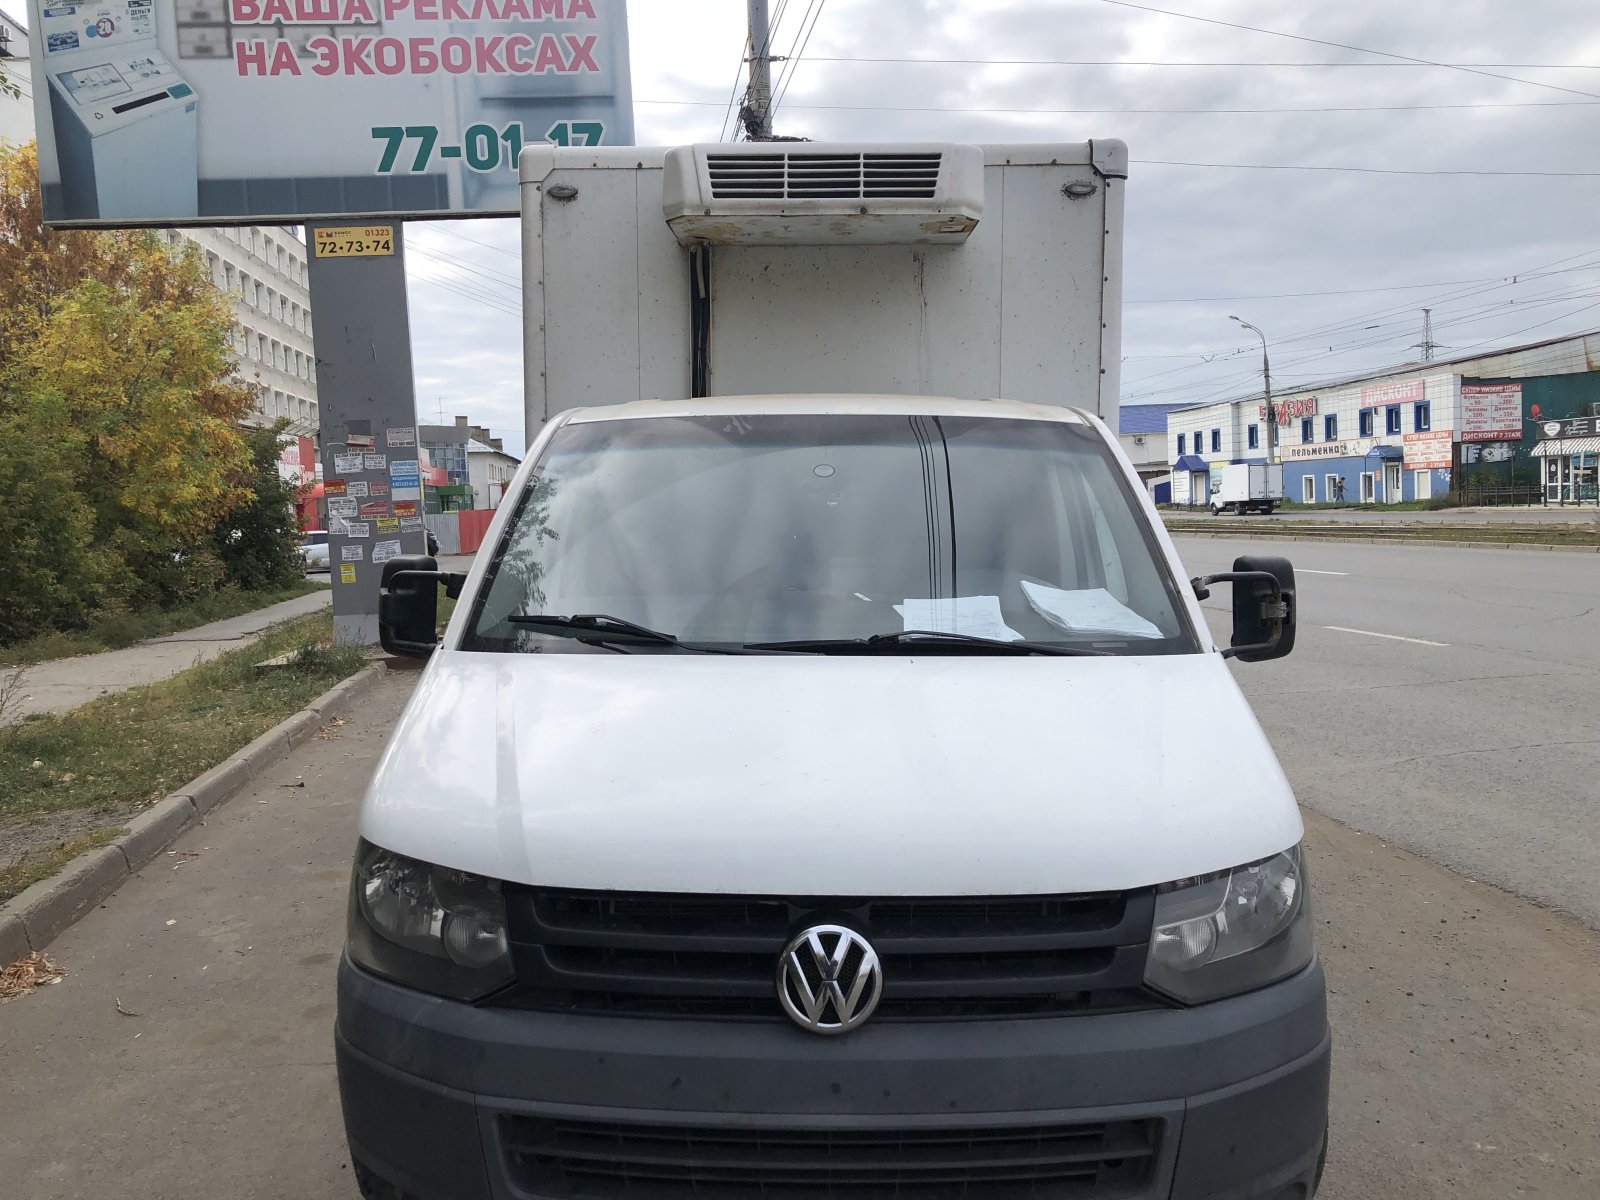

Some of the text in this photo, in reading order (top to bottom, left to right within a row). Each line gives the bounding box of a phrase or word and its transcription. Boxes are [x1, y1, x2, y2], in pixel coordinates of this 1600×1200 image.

[232, 0, 597, 21] ВАША РЕКЛАМА
[235, 35, 600, 76] НА ЭКОБОКСАХ
[371, 122, 603, 171] 77-0117
[365, 228, 390, 237] 01323
[1365, 383, 1418, 403] ДИСКОНТ
[1504, 384, 1521, 393] ЦЕНЫ
[1258, 397, 1317, 427] ЕРАЗИЯ
[1462, 432, 1498, 441] ДИСКОНТ
